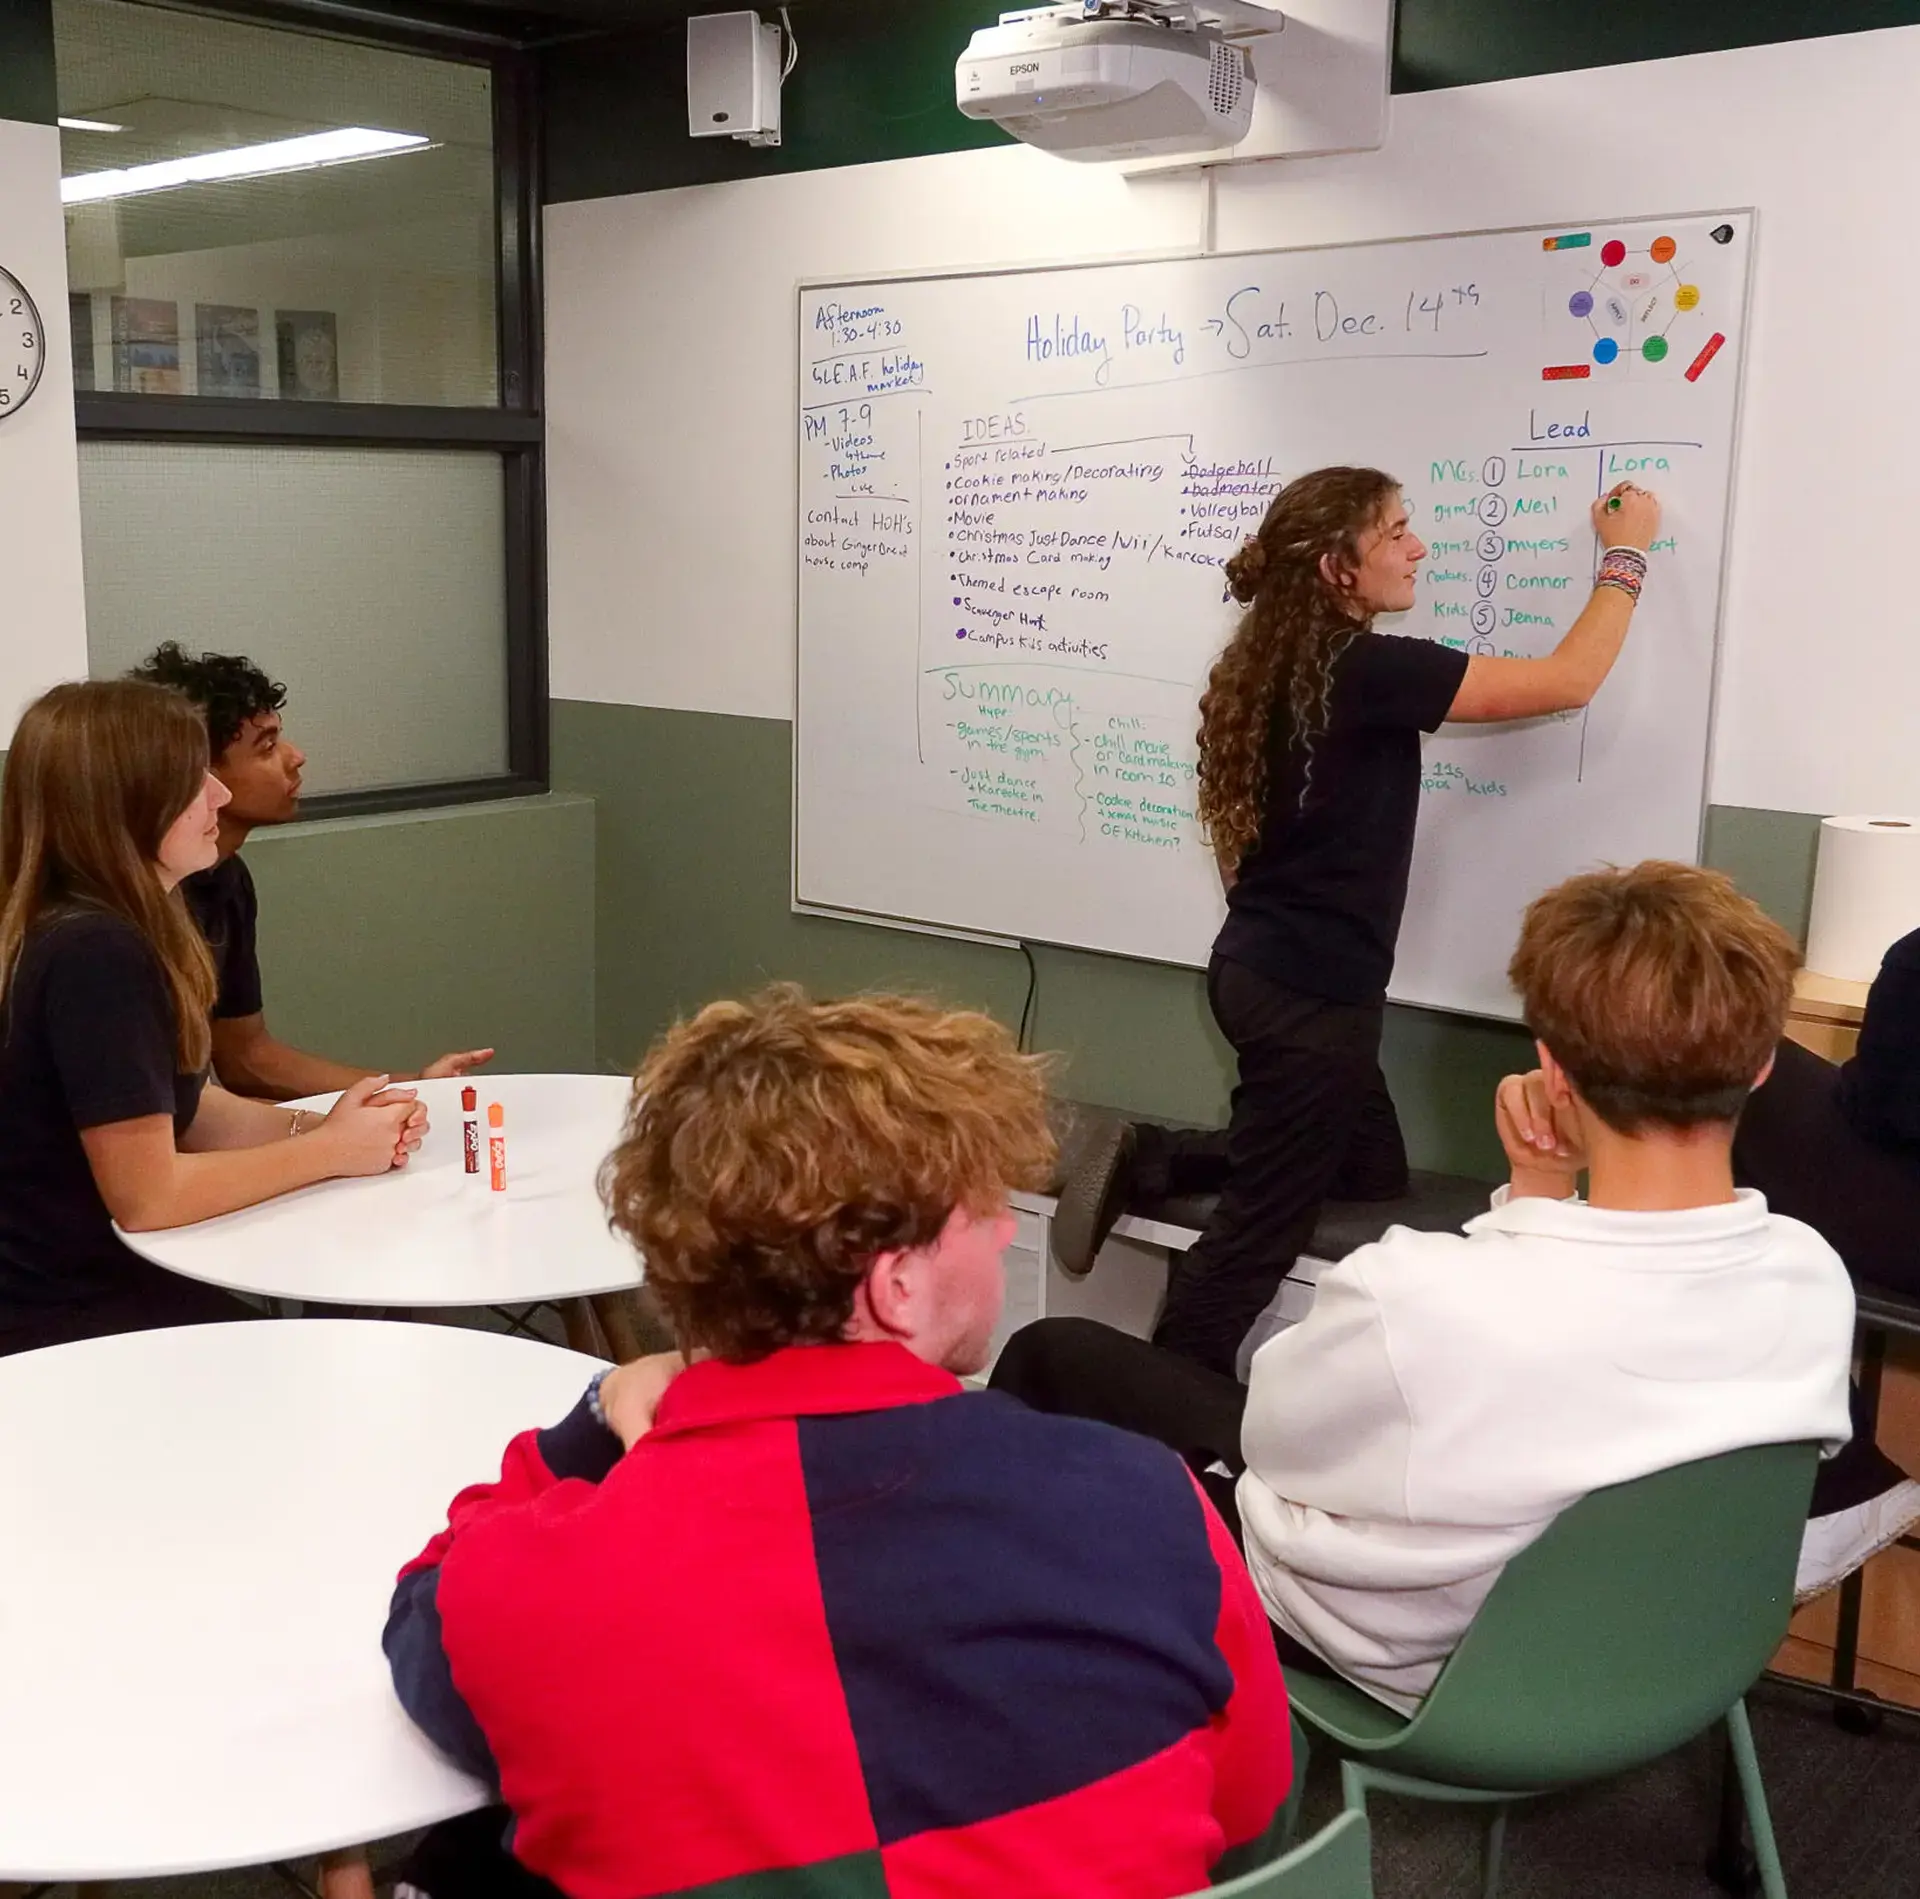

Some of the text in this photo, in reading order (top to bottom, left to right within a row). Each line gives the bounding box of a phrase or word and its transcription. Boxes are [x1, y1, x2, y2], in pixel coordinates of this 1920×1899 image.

[1010, 62, 1040, 76] EPSON
[10, 298, 23, 315] 2
[815, 303, 885, 330] Afternoon
[22, 332, 34, 348] 3
[1027, 313, 1113, 385] Holiday
[1122, 304, 1185, 365] Party
[1226, 286, 1292, 359] Sat.
[1314, 290, 1385, 342] Dec.
[17, 364, 28, 380] 4
[882, 354, 924, 386] holiday
[867, 375, 912, 392] market
[0, 388, 10, 405] 5
[804, 403, 872, 441] PM 7-9
[1530, 408, 1590, 440] Lead
[832, 433, 873, 451] Videos
[994, 442, 1046, 463] related
[1517, 459, 1569, 479] Lora
[1608, 453, 1670, 473] Lora
[830, 464, 868, 481] Photos
[953, 473, 1005, 490] Cookie
[1512, 496, 1557, 517] Neil
[953, 510, 995, 526] Movie
[804, 532, 837, 548] about
[956, 528, 1025, 546] Christmas
[1188, 521, 1240, 542] Futsal
[958, 548, 1019, 564] Christmas
[805, 554, 869, 577] house comp
[958, 573, 1109, 602] Themed escape room
[1506, 573, 1574, 591] Connor
[1501, 607, 1555, 627] Jenna
[967, 630, 1015, 648] Campus
[1048, 636, 1109, 660] activities
[967, 739, 1045, 763] in the gym
[1096, 750, 1113, 762] or
[998, 772, 1037, 789] dance
[1093, 764, 1177, 787] in room 10
[1032, 793, 1045, 802] in
